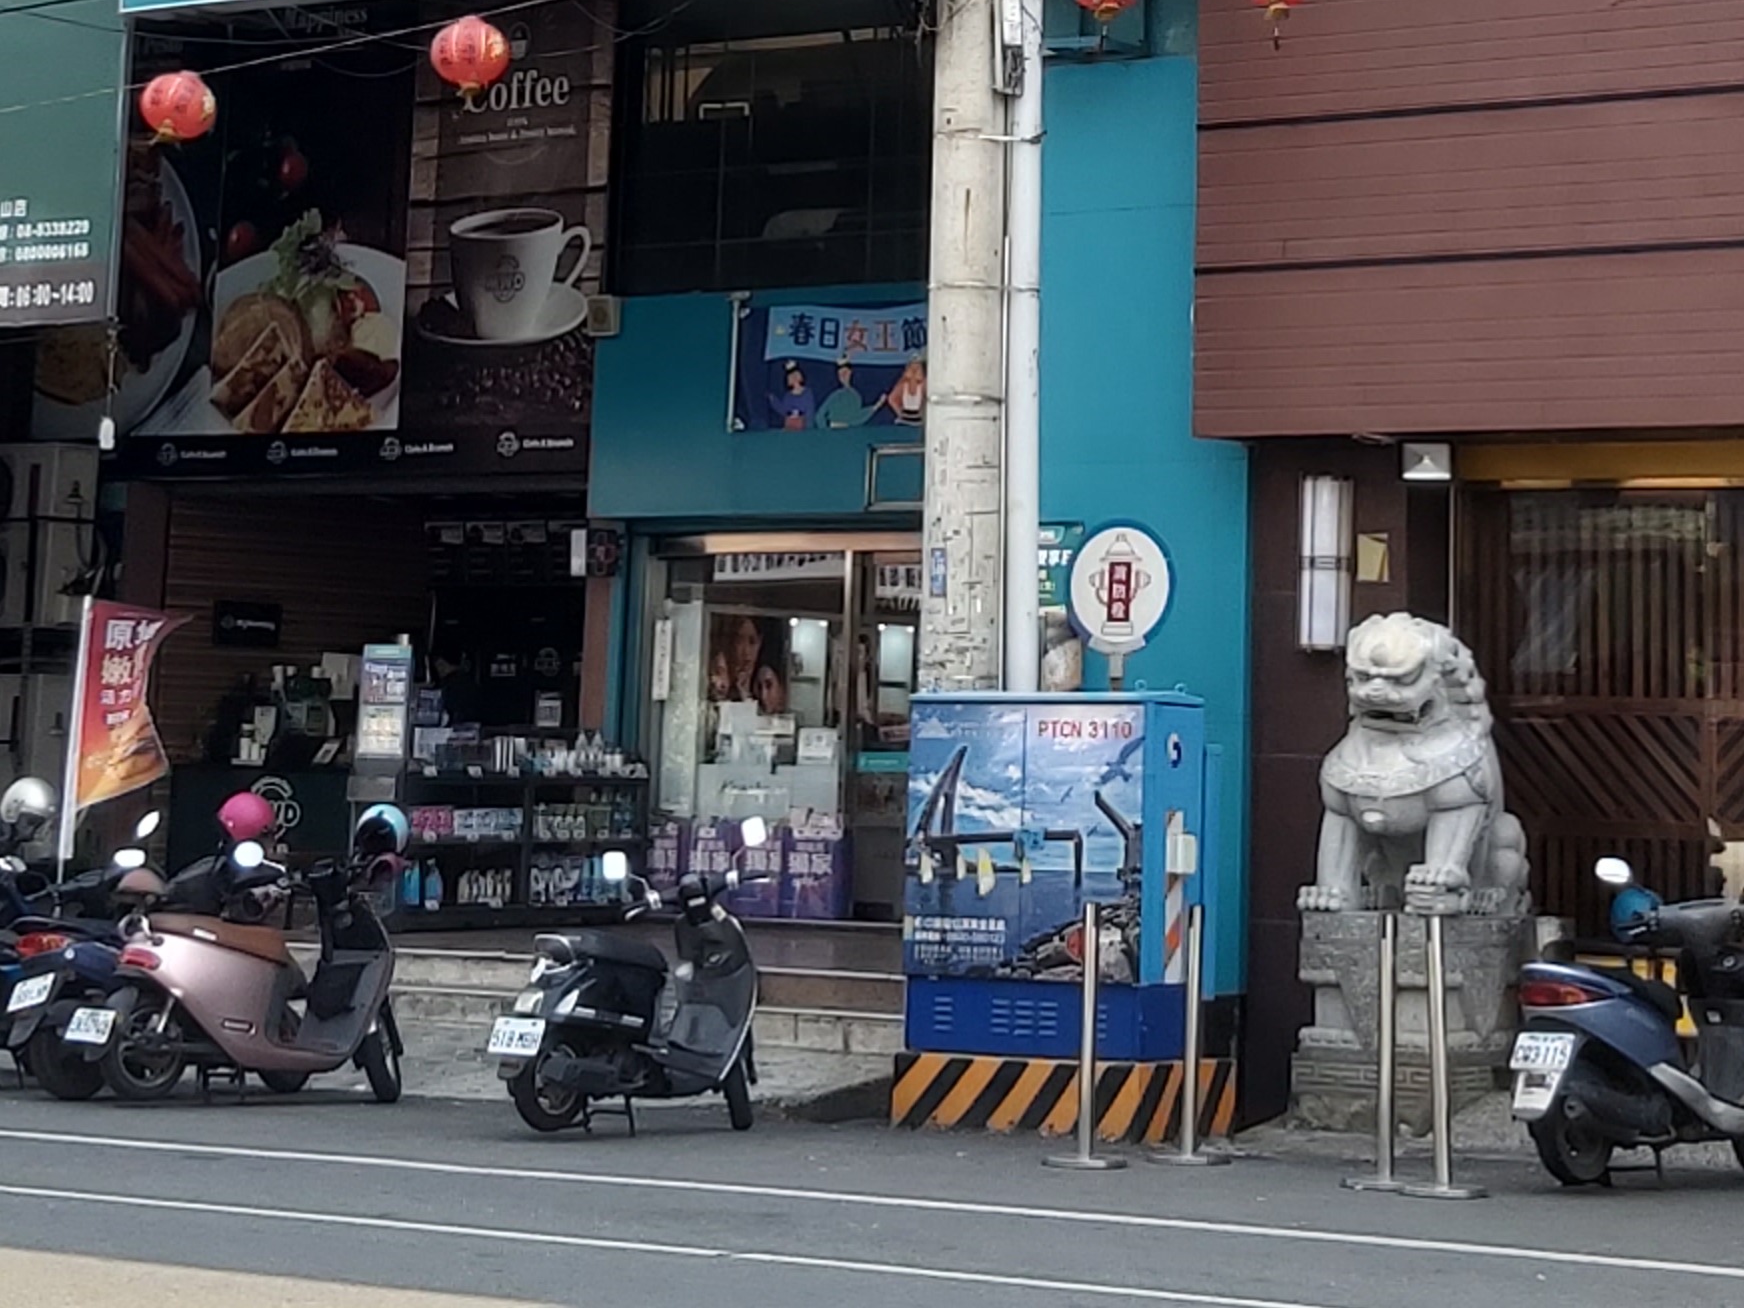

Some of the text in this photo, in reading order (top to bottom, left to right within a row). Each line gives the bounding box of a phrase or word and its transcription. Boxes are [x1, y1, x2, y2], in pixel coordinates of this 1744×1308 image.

[463, 69, 571, 113] Coffee
[787, 312, 928, 353] 春日女王節
[1038, 719, 1133, 740] PTCN 3110
